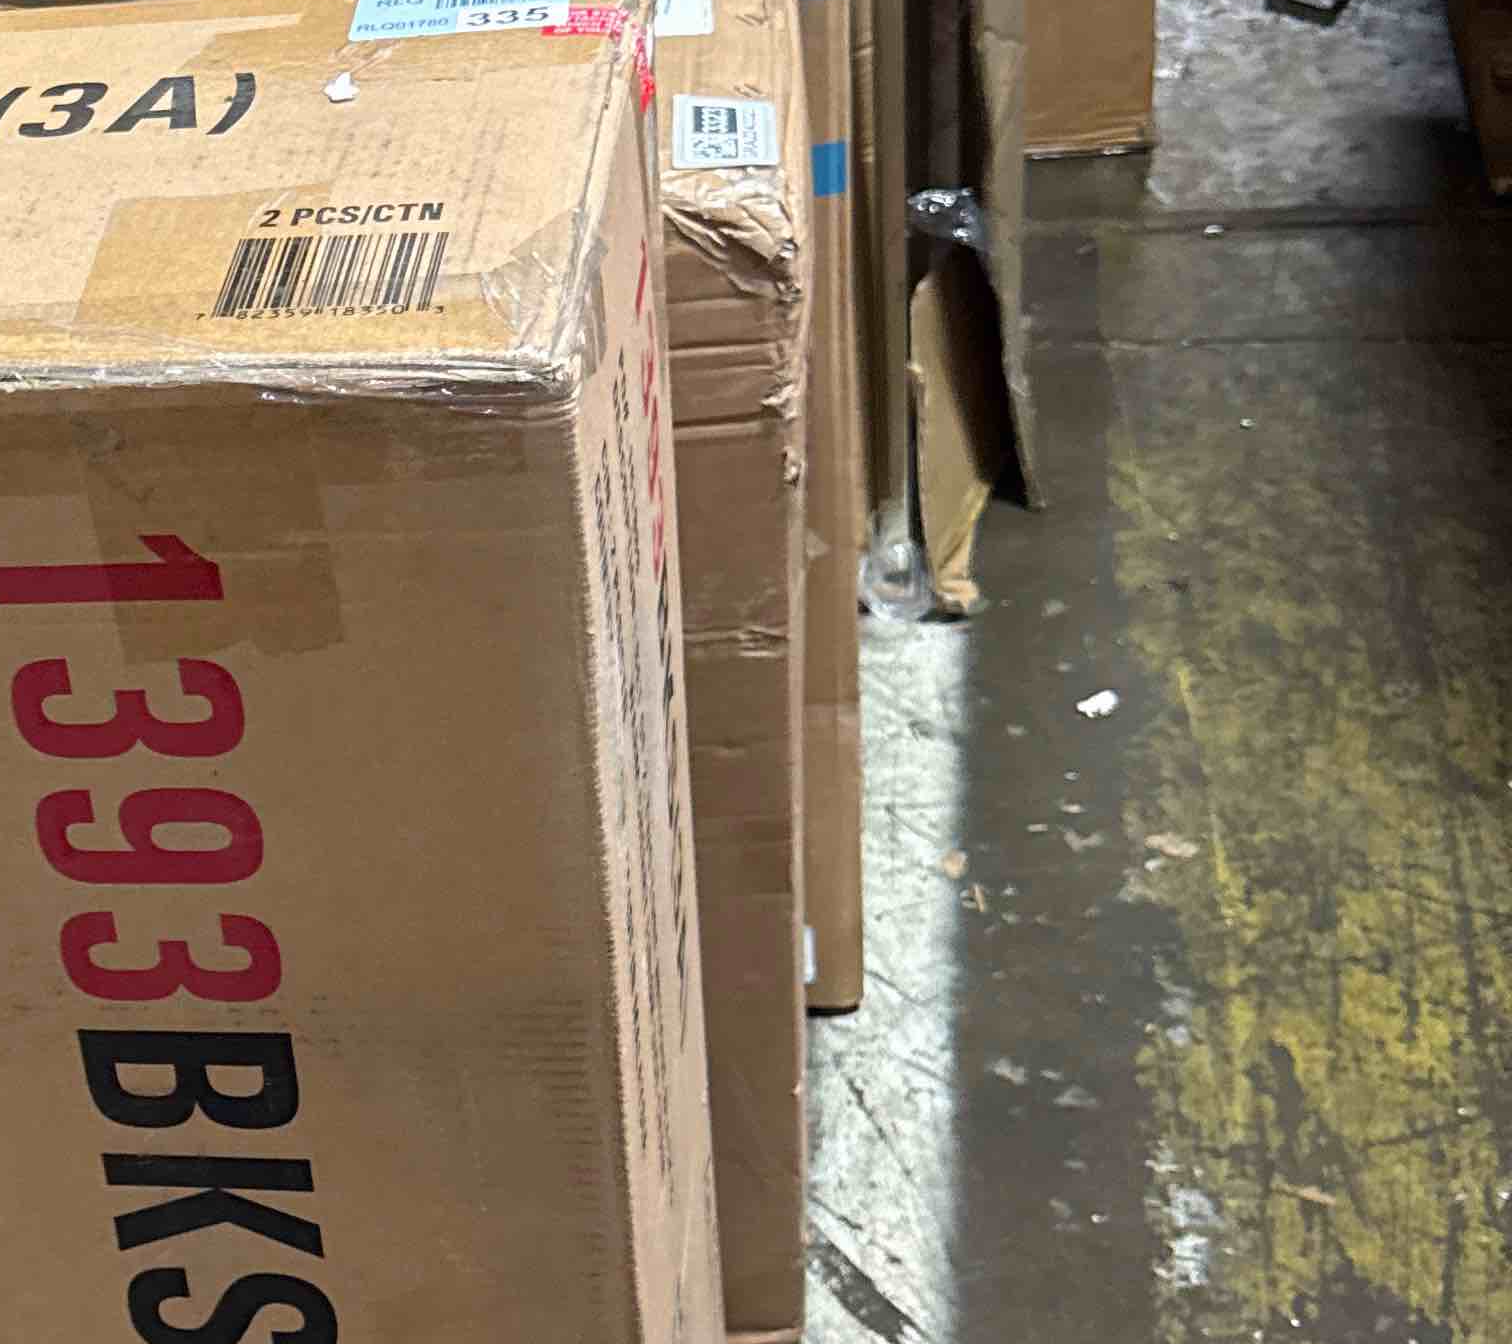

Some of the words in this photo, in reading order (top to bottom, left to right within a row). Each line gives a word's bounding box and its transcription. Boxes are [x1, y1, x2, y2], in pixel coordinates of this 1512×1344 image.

[466, 6, 551, 27] 335
[258, 209, 282, 228] 2
[289, 202, 444, 227] PCS/CTN
